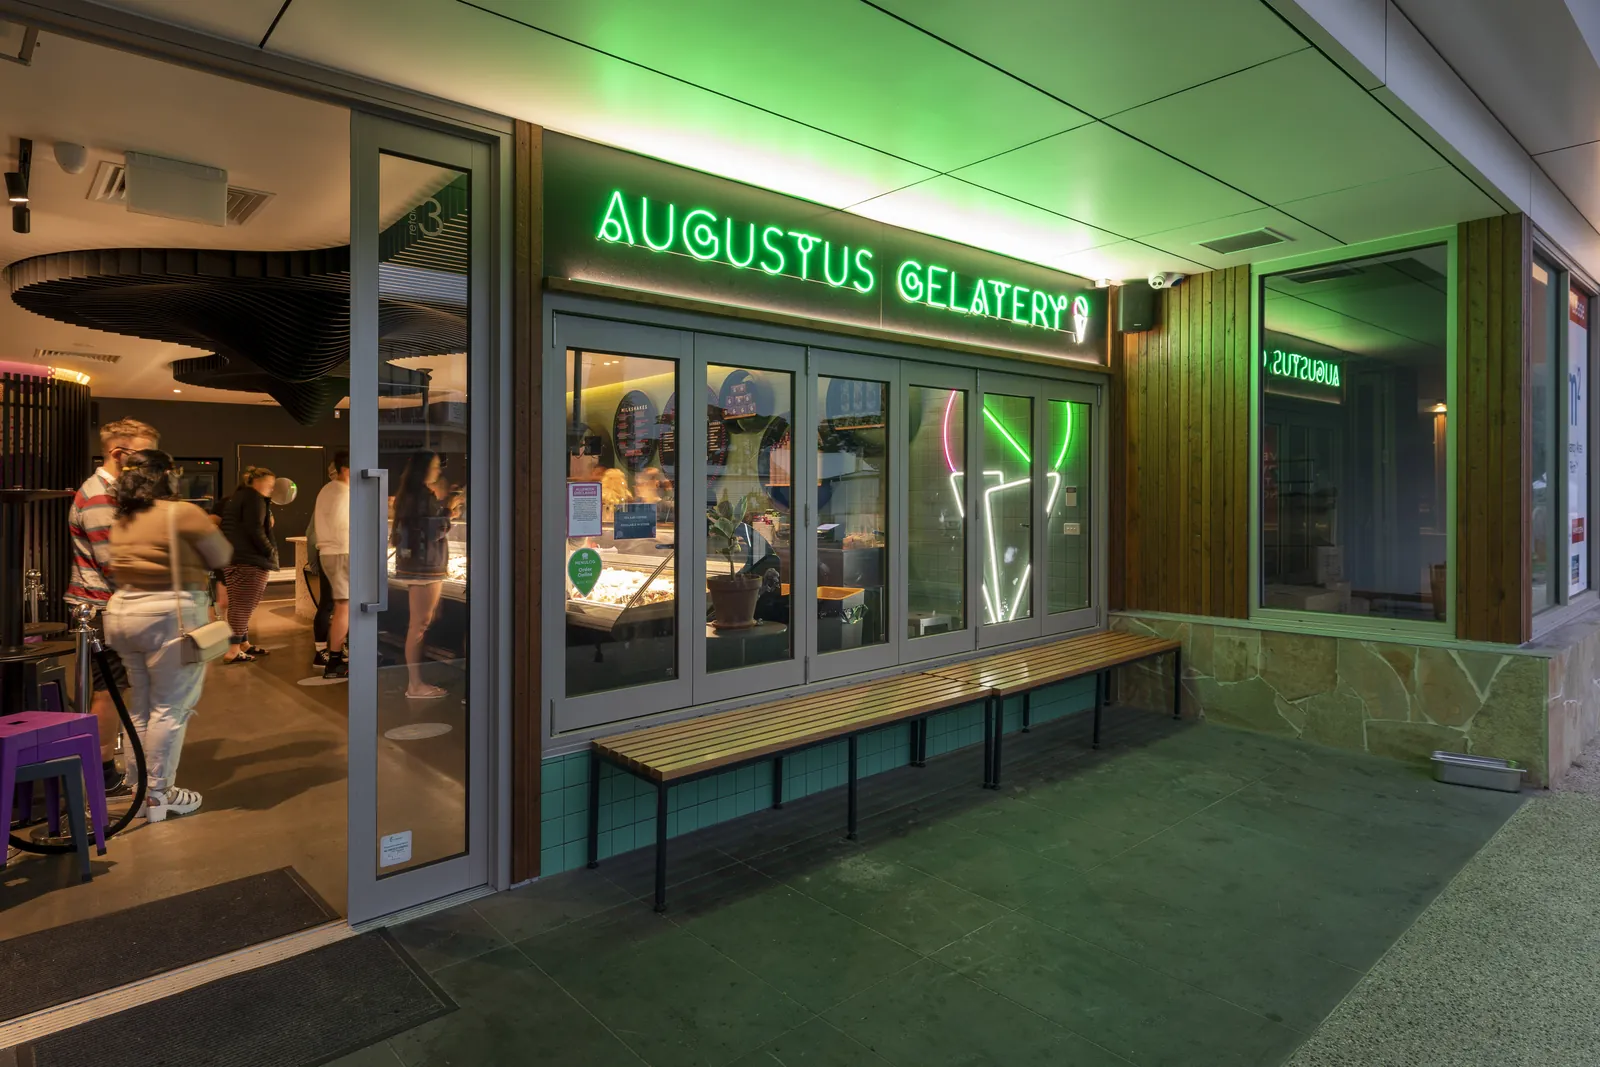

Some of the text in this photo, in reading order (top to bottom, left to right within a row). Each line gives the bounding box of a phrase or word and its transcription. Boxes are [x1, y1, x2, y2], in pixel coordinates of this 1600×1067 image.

[418, 197, 443, 236] 3
[597, 189, 1068, 331] AUGUSTUS GELATERY
[621, 404, 648, 413] MILKSHAKES
